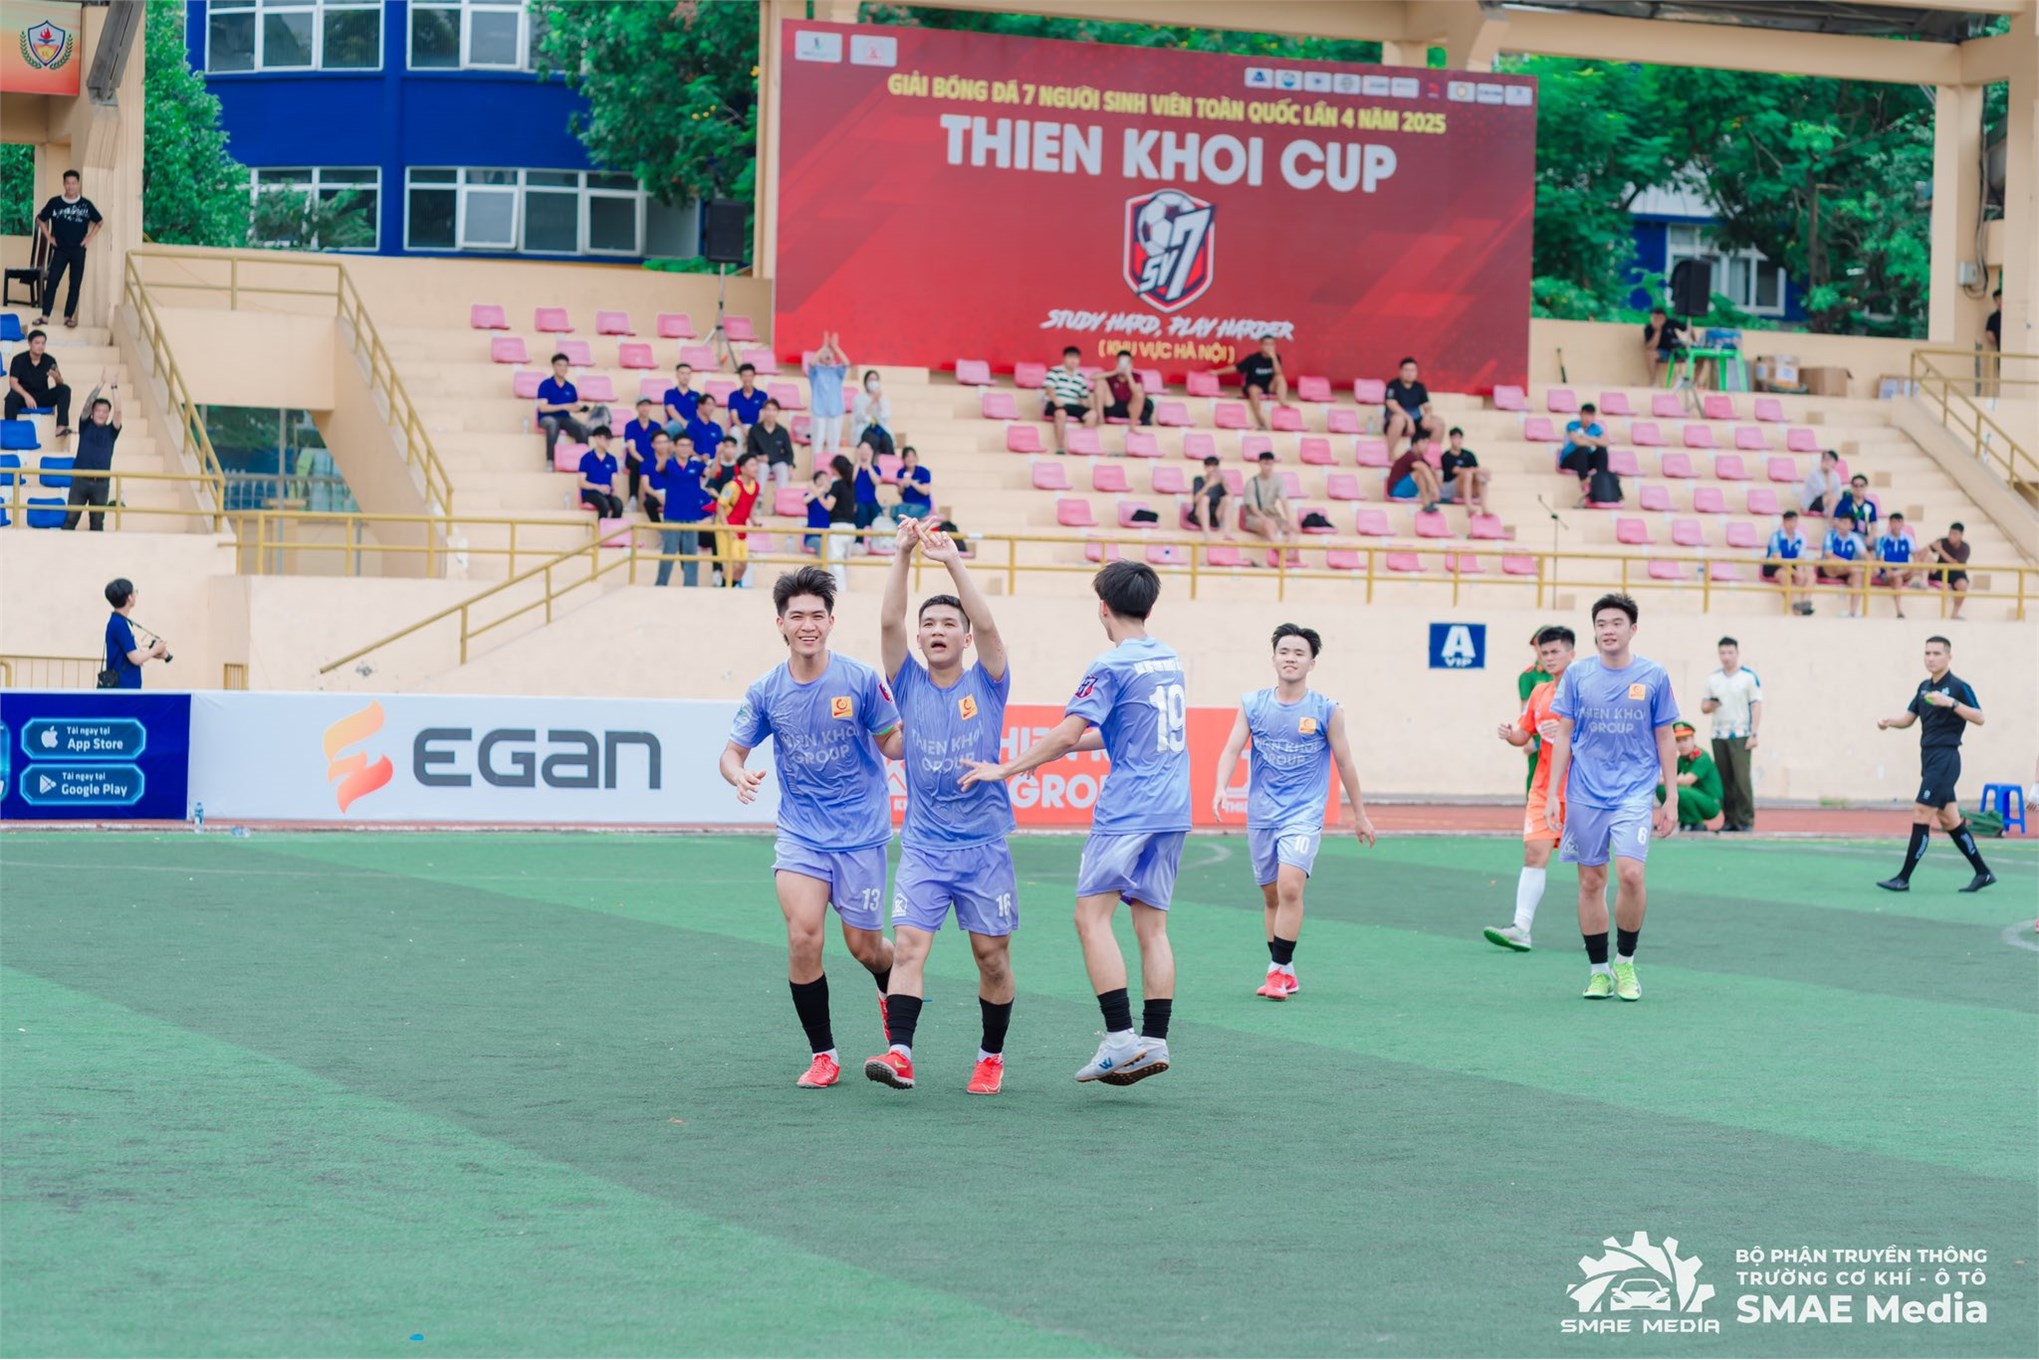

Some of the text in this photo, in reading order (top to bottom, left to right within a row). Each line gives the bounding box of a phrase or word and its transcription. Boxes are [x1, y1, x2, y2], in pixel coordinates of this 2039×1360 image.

[1022, 84, 1036, 105] 7
[1102, 90, 1147, 115] SINH
[1150, 91, 1192, 118] VIÊN
[1340, 108, 1355, 129] 4
[1401, 112, 1447, 134] 2025
[940, 114, 1398, 193] THIEN KHOI CUP
[1040, 309, 1105, 332] STUDY
[1167, 315, 1218, 338] PLAY
[1441, 625, 1476, 658] A
[1444, 656, 1473, 668] VIP
[1148, 684, 1185, 753] 19
[1589, 722, 1634, 734] GROUP
[80, 727, 98, 736] ngay
[67, 738, 123, 752] App Store
[75, 773, 94, 782] ngay
[61, 783, 127, 798] Google Play
[1010, 773, 1109, 809] GRO
[1295, 834, 1310, 854] 10
[1637, 826, 1648, 845] 6
[862, 888, 881, 911] 13
[995, 892, 1012, 917] 16
